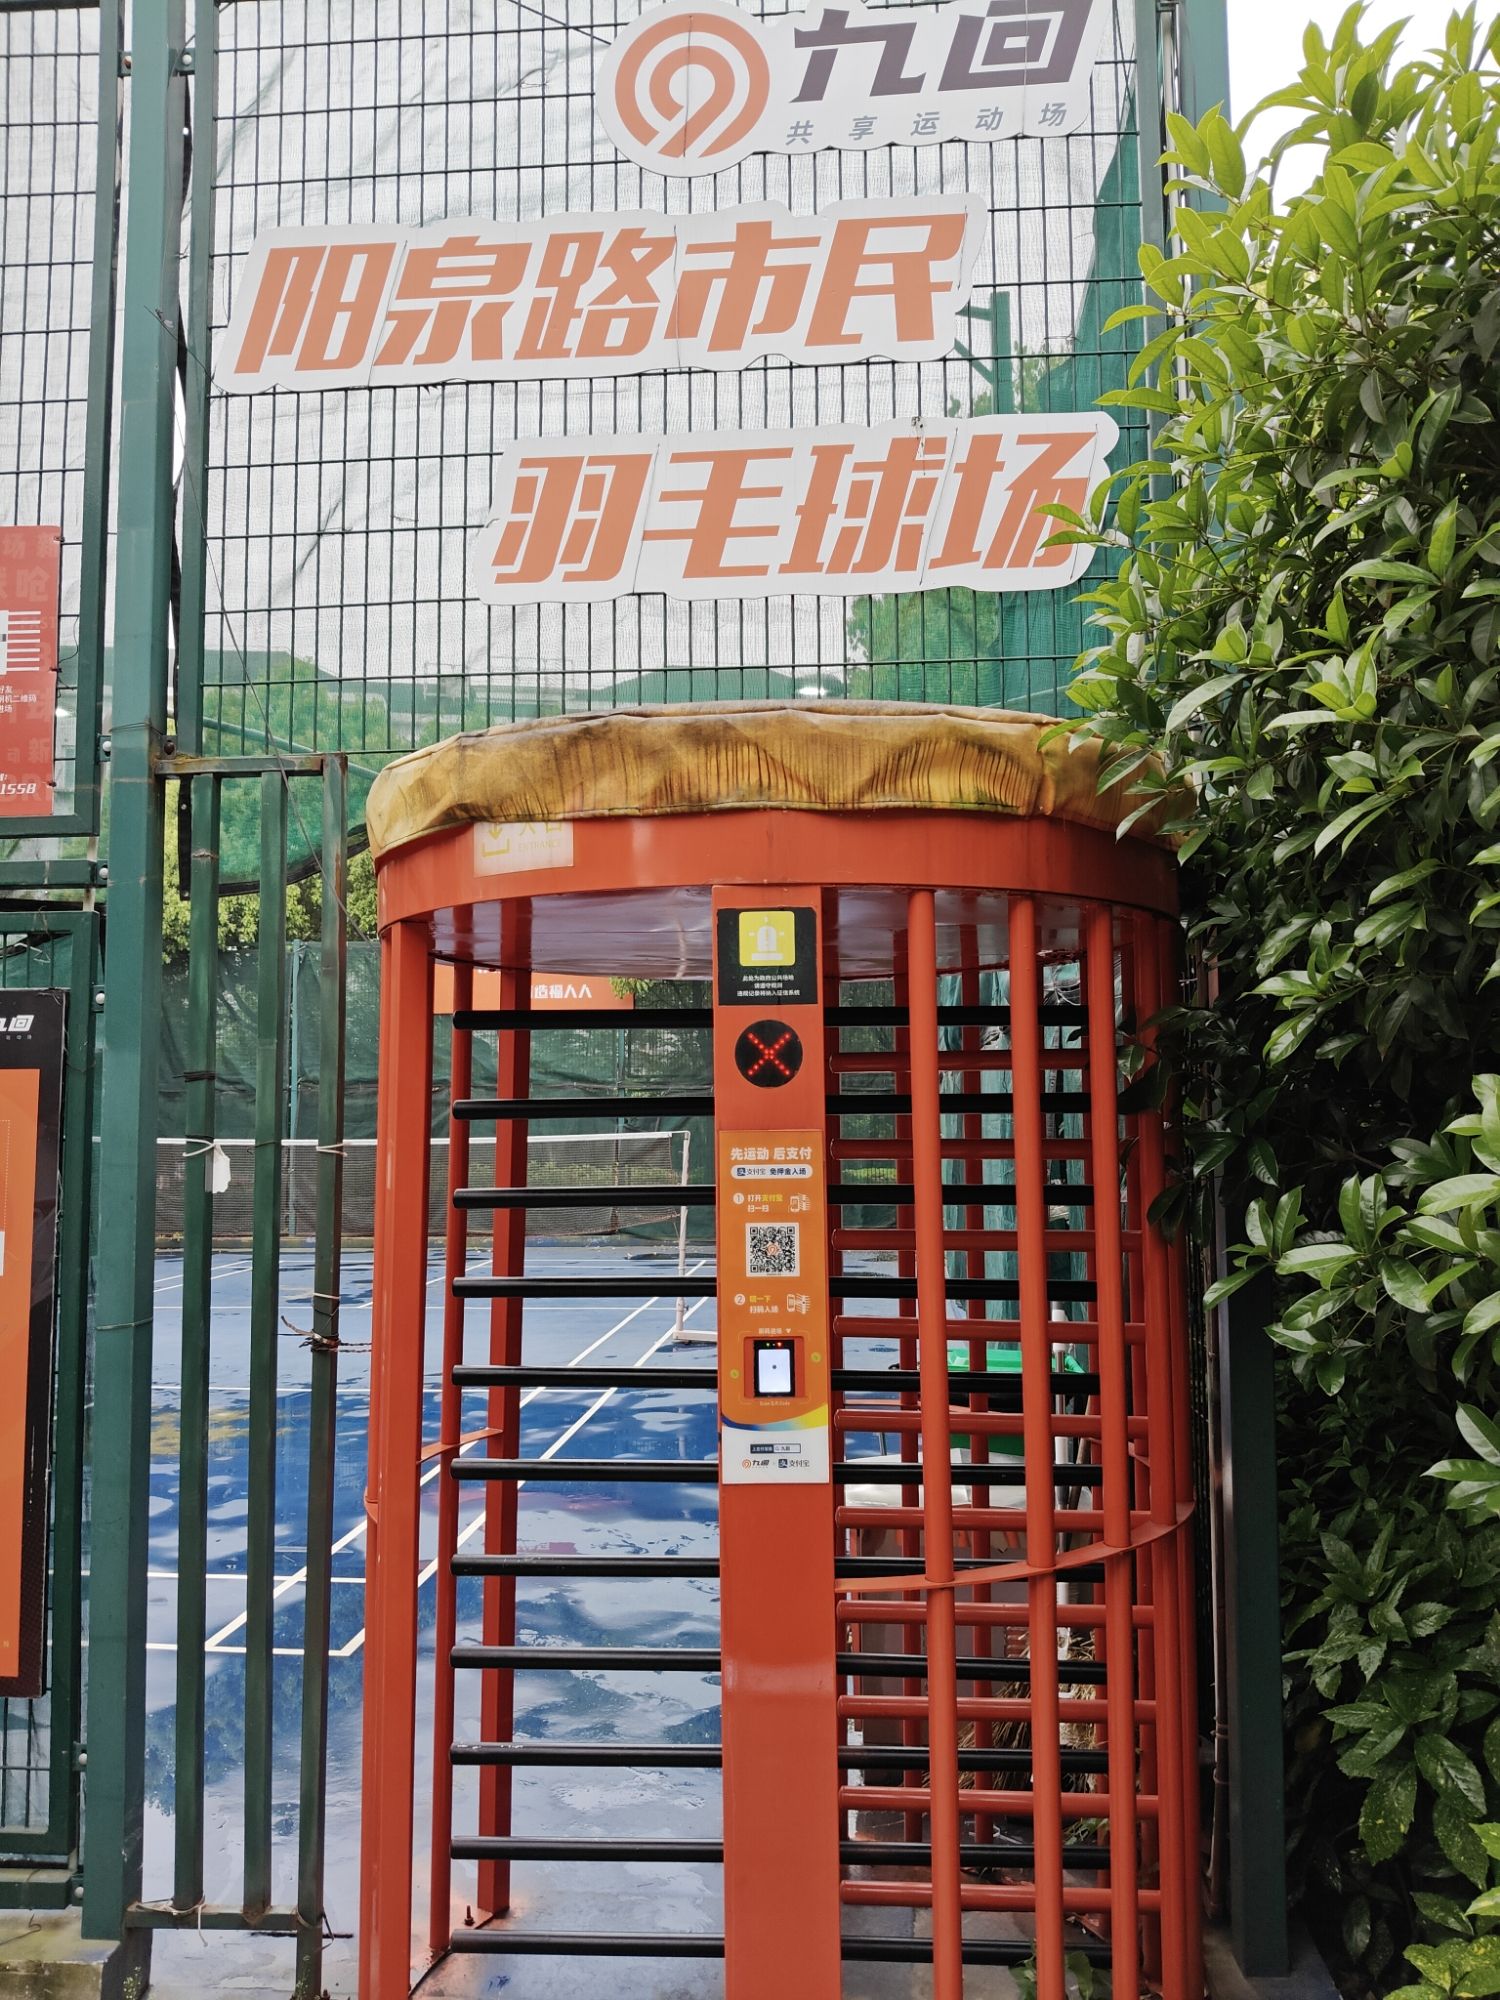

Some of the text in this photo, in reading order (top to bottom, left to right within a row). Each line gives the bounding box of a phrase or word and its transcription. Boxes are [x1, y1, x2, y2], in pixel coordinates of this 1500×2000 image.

[787, 101, 1068, 146] 共享运动场
[232, 212, 968, 375] 阳泉路市民
[491, 432, 1098, 585] 羽毛球场
[0, 783, 37, 795] 1558
[531, 983, 592, 999] 造福人人
[730, 1147, 812, 1161] 先运动 后支付
[746, 1167, 807, 1176] 支付宝 免押金入场
[747, 1204, 769, 1213] 扫一扫
[788, 1459, 810, 1467] 支付宝
